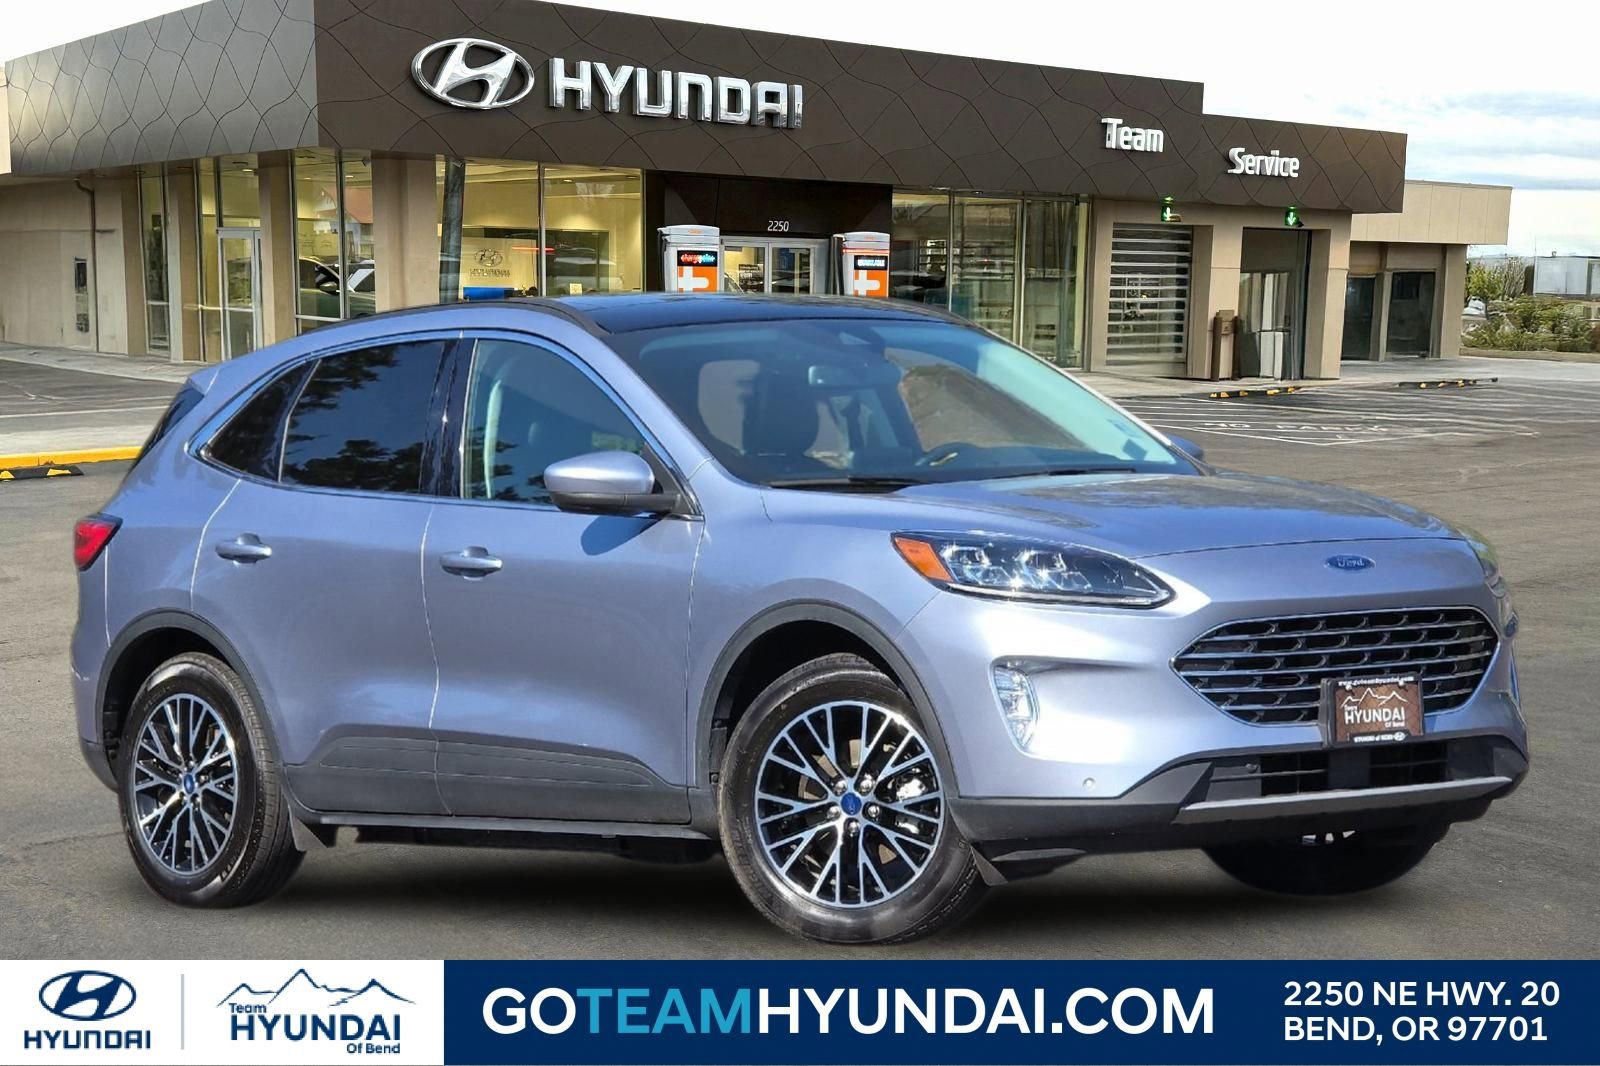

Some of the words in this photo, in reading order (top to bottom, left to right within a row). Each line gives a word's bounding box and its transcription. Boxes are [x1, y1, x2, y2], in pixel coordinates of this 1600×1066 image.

[549, 57, 804, 129] HYUNDAI
[1101, 116, 1164, 153] Team
[1227, 146, 1300, 179] Service
[767, 220, 790, 232] 2250
[1345, 707, 1405, 724] HYUNDAI
